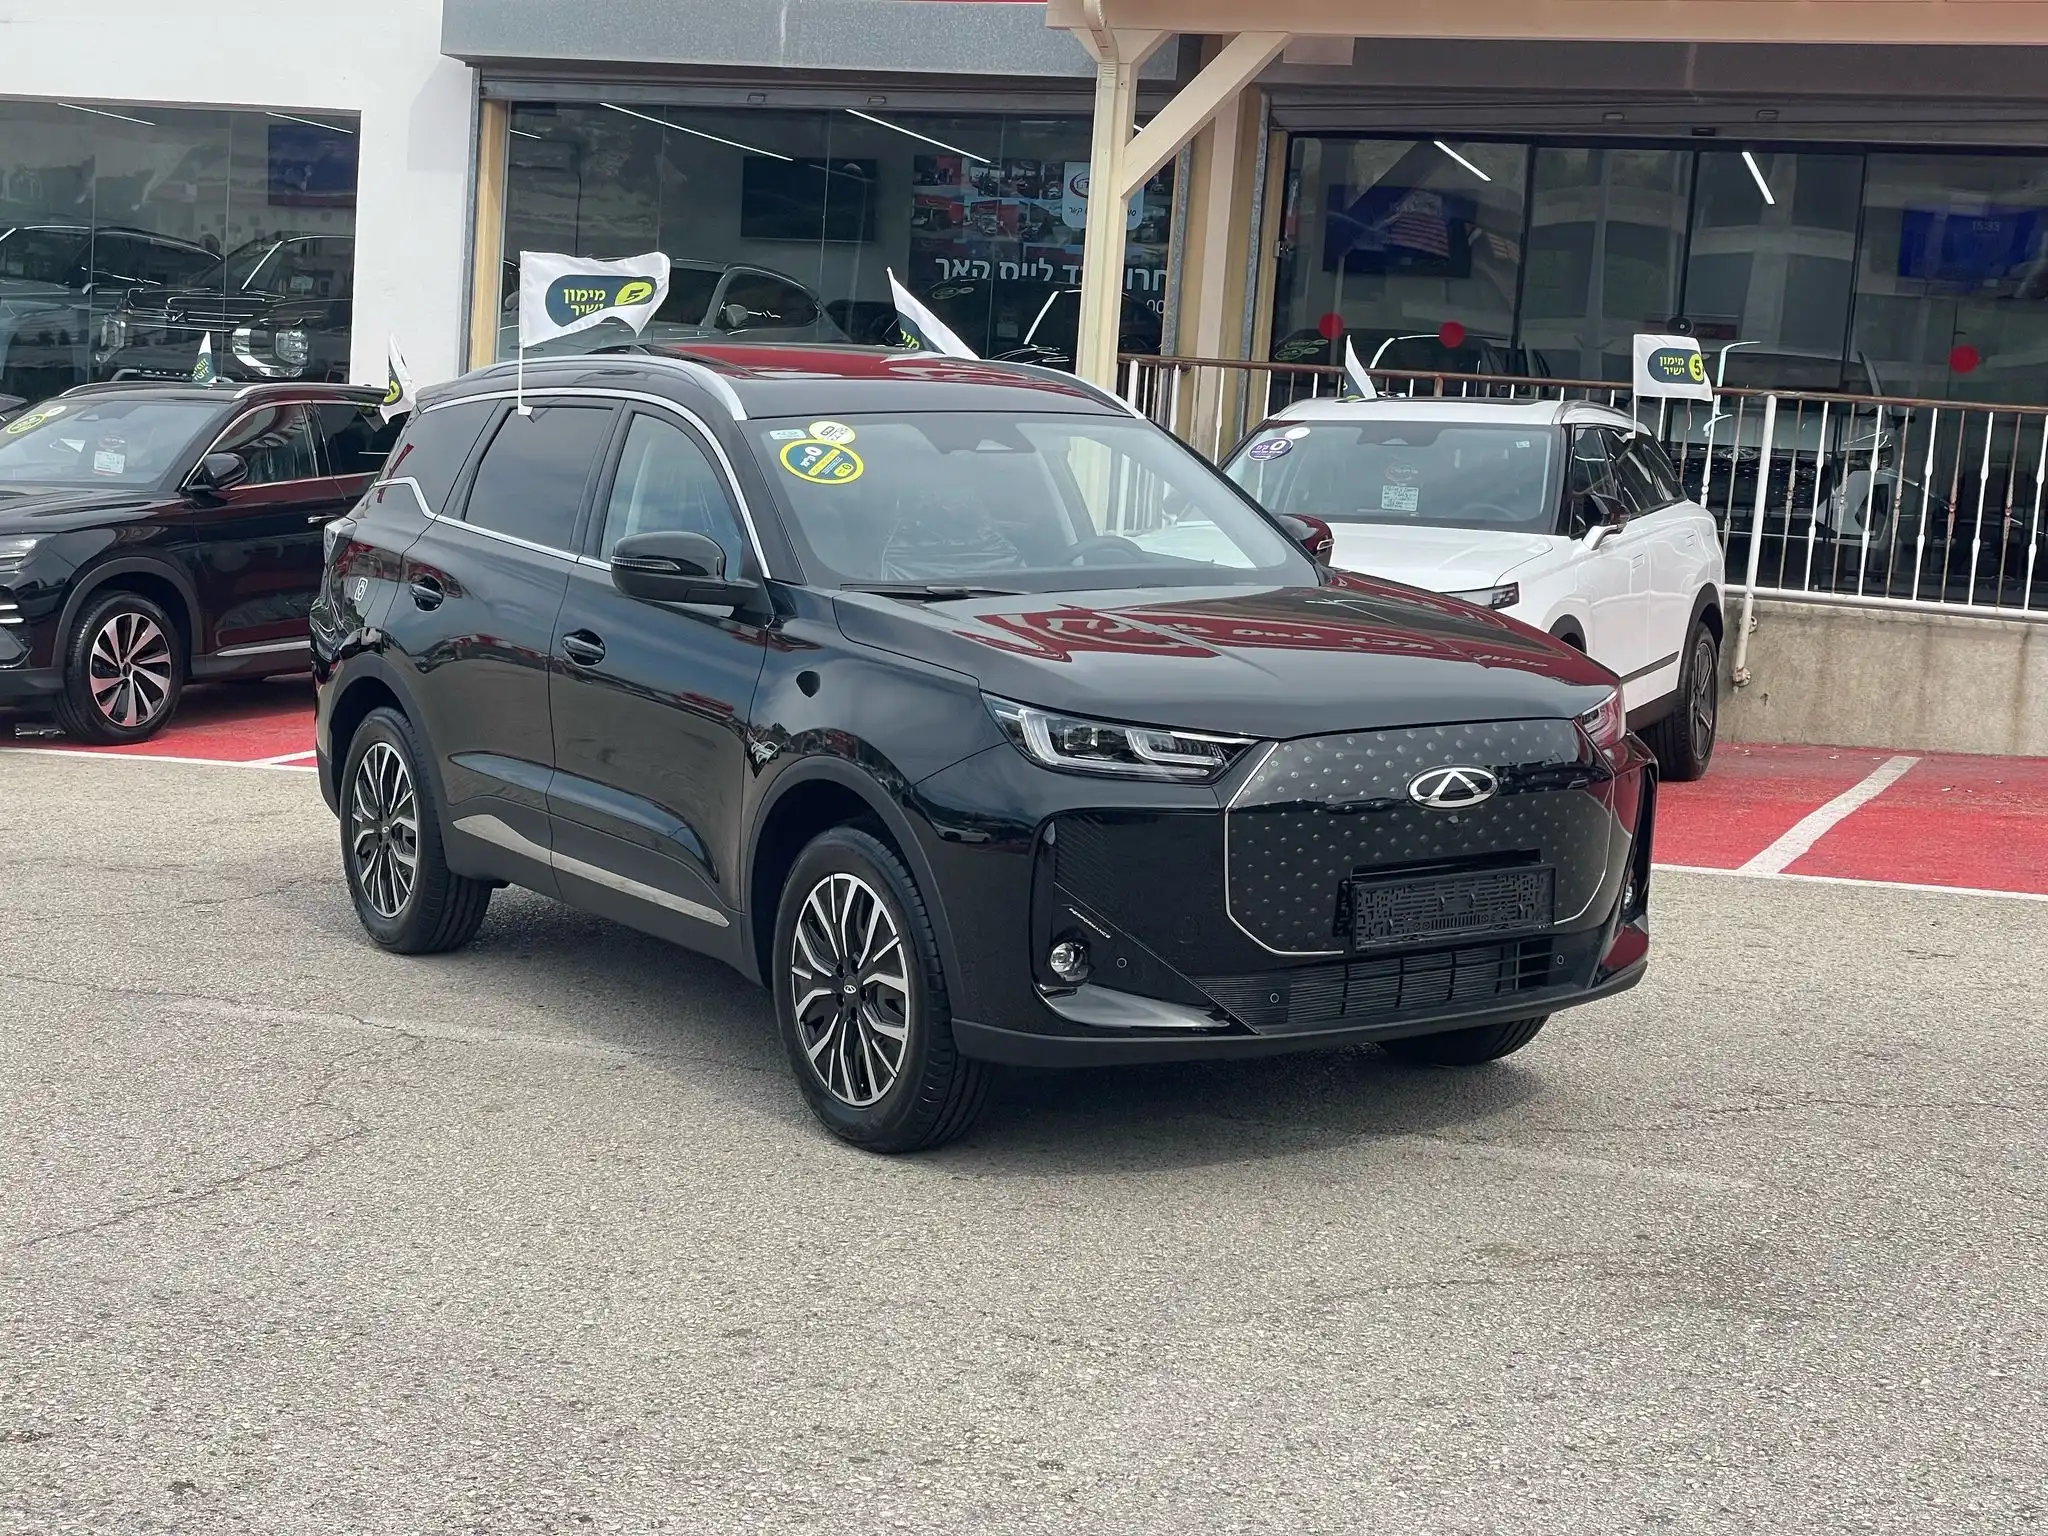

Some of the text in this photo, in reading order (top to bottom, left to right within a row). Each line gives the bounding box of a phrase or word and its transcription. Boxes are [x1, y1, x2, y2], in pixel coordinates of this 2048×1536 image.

[563, 288, 606, 304] מימון
[570, 303, 604, 316] ישיר
[1660, 356, 1684, 366] מימון
[1664, 367, 1685, 375] ישיר
